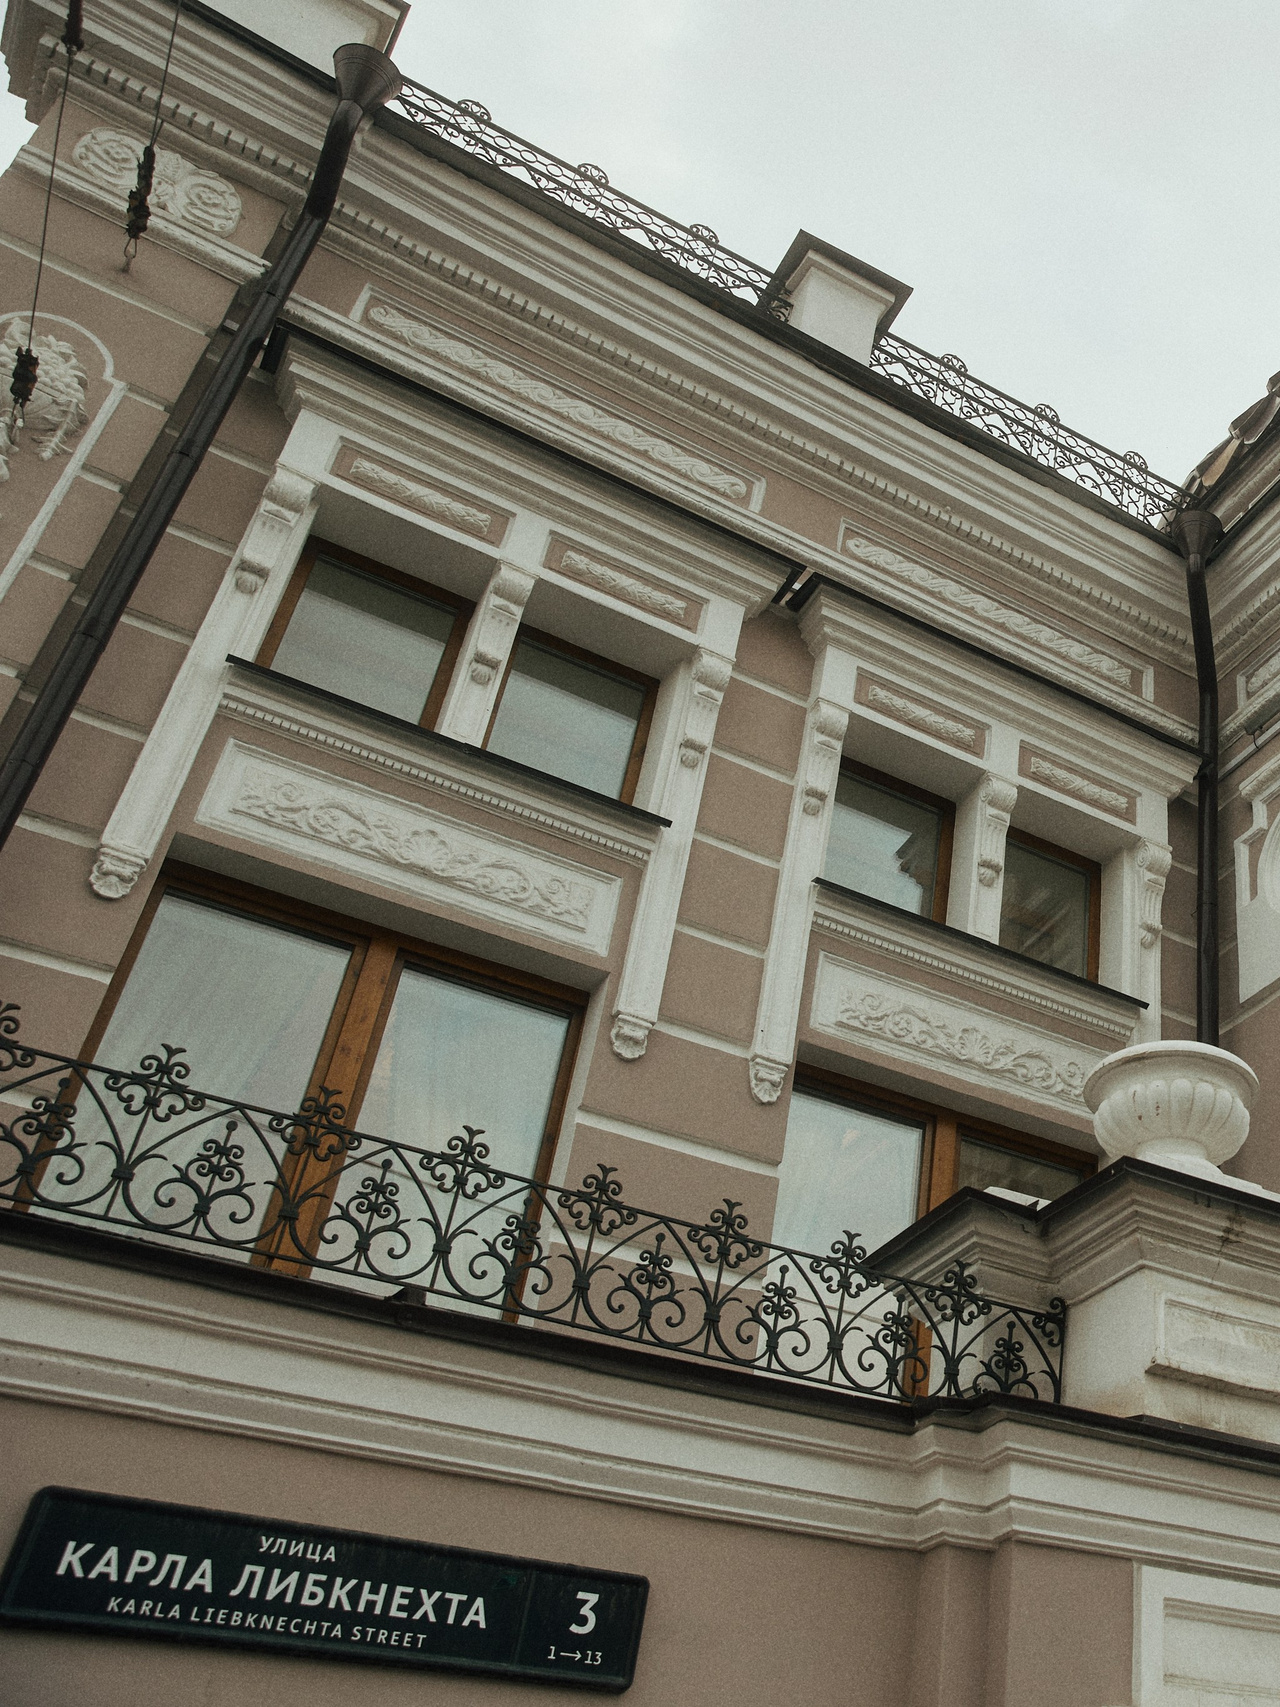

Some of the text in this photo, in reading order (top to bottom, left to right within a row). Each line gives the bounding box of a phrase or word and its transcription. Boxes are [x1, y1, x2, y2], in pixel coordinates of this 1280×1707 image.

[258, 1535, 337, 1562] УЛИЦА
[56, 1540, 487, 1629] КАРЛА ЛИБКНЕХТА
[107, 1596, 427, 1649] KARLA LIEBKNECHTA STREET
[568, 1591, 601, 1635] 3
